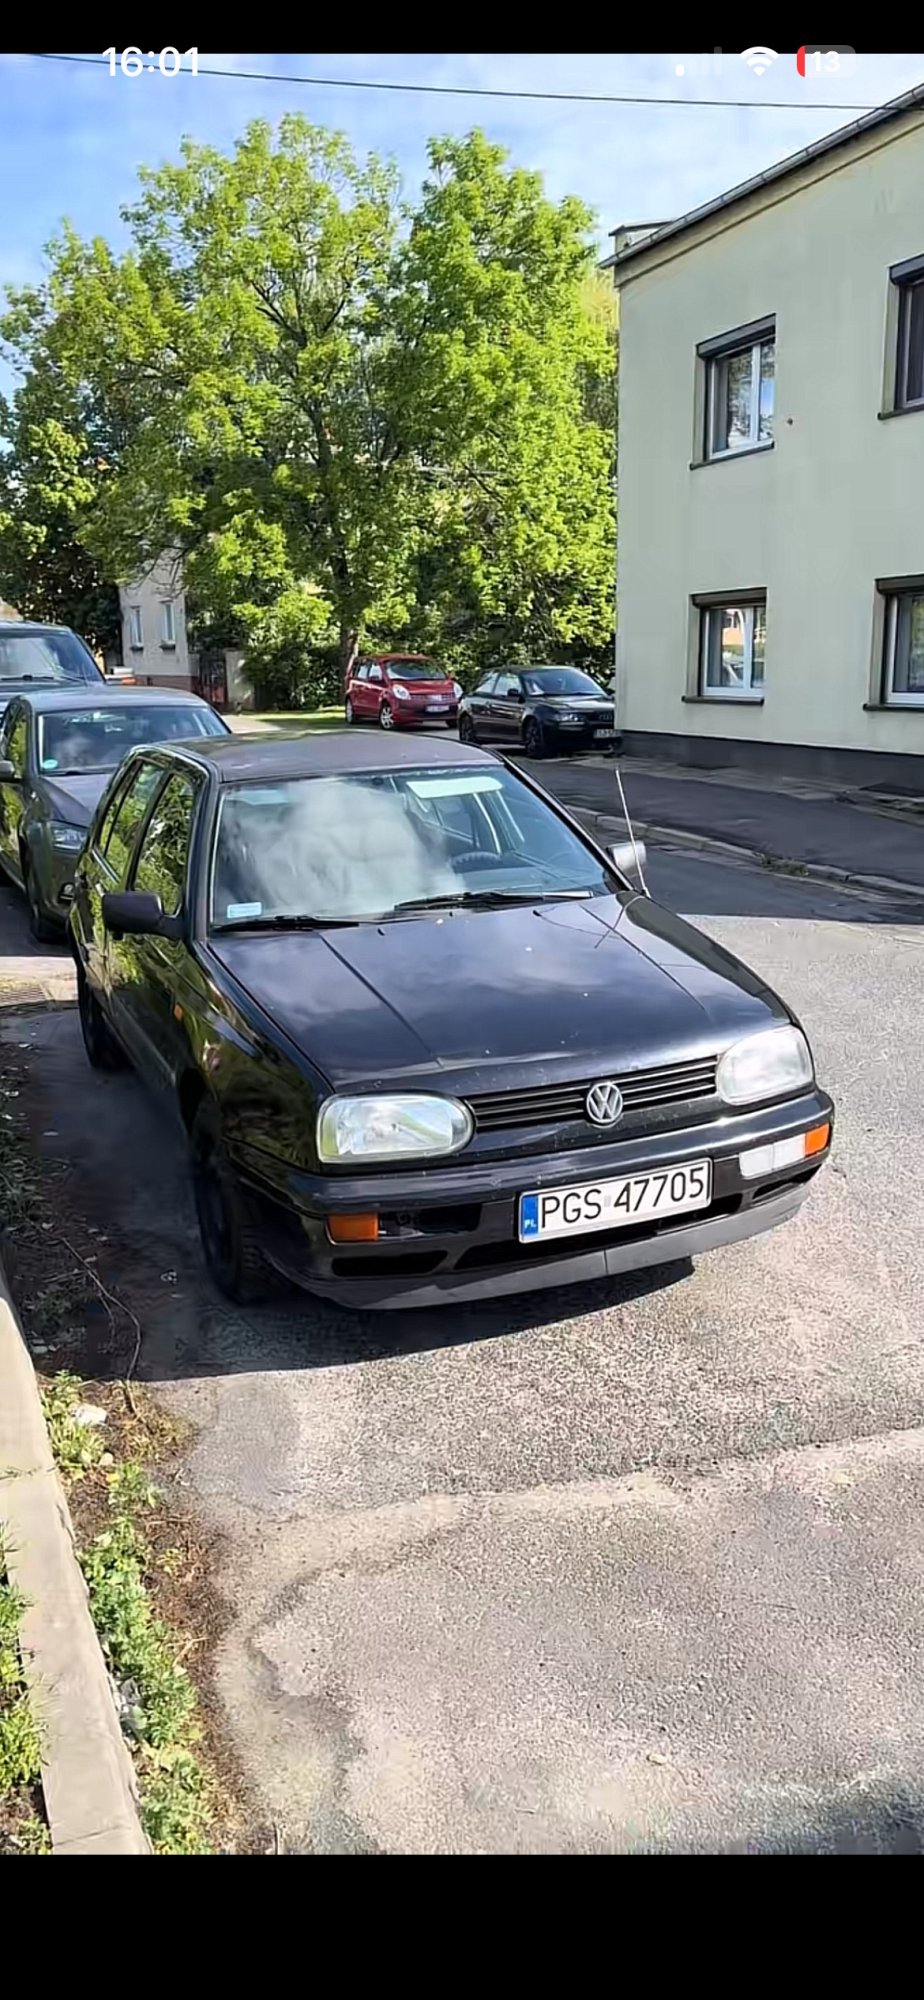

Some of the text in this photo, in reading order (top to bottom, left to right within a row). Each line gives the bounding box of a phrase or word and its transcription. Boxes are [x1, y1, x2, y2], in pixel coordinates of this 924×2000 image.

[588, 1083, 621, 1122] VW
[541, 1166, 705, 1229] PGS 47705
[524, 1219, 537, 1229] PL
